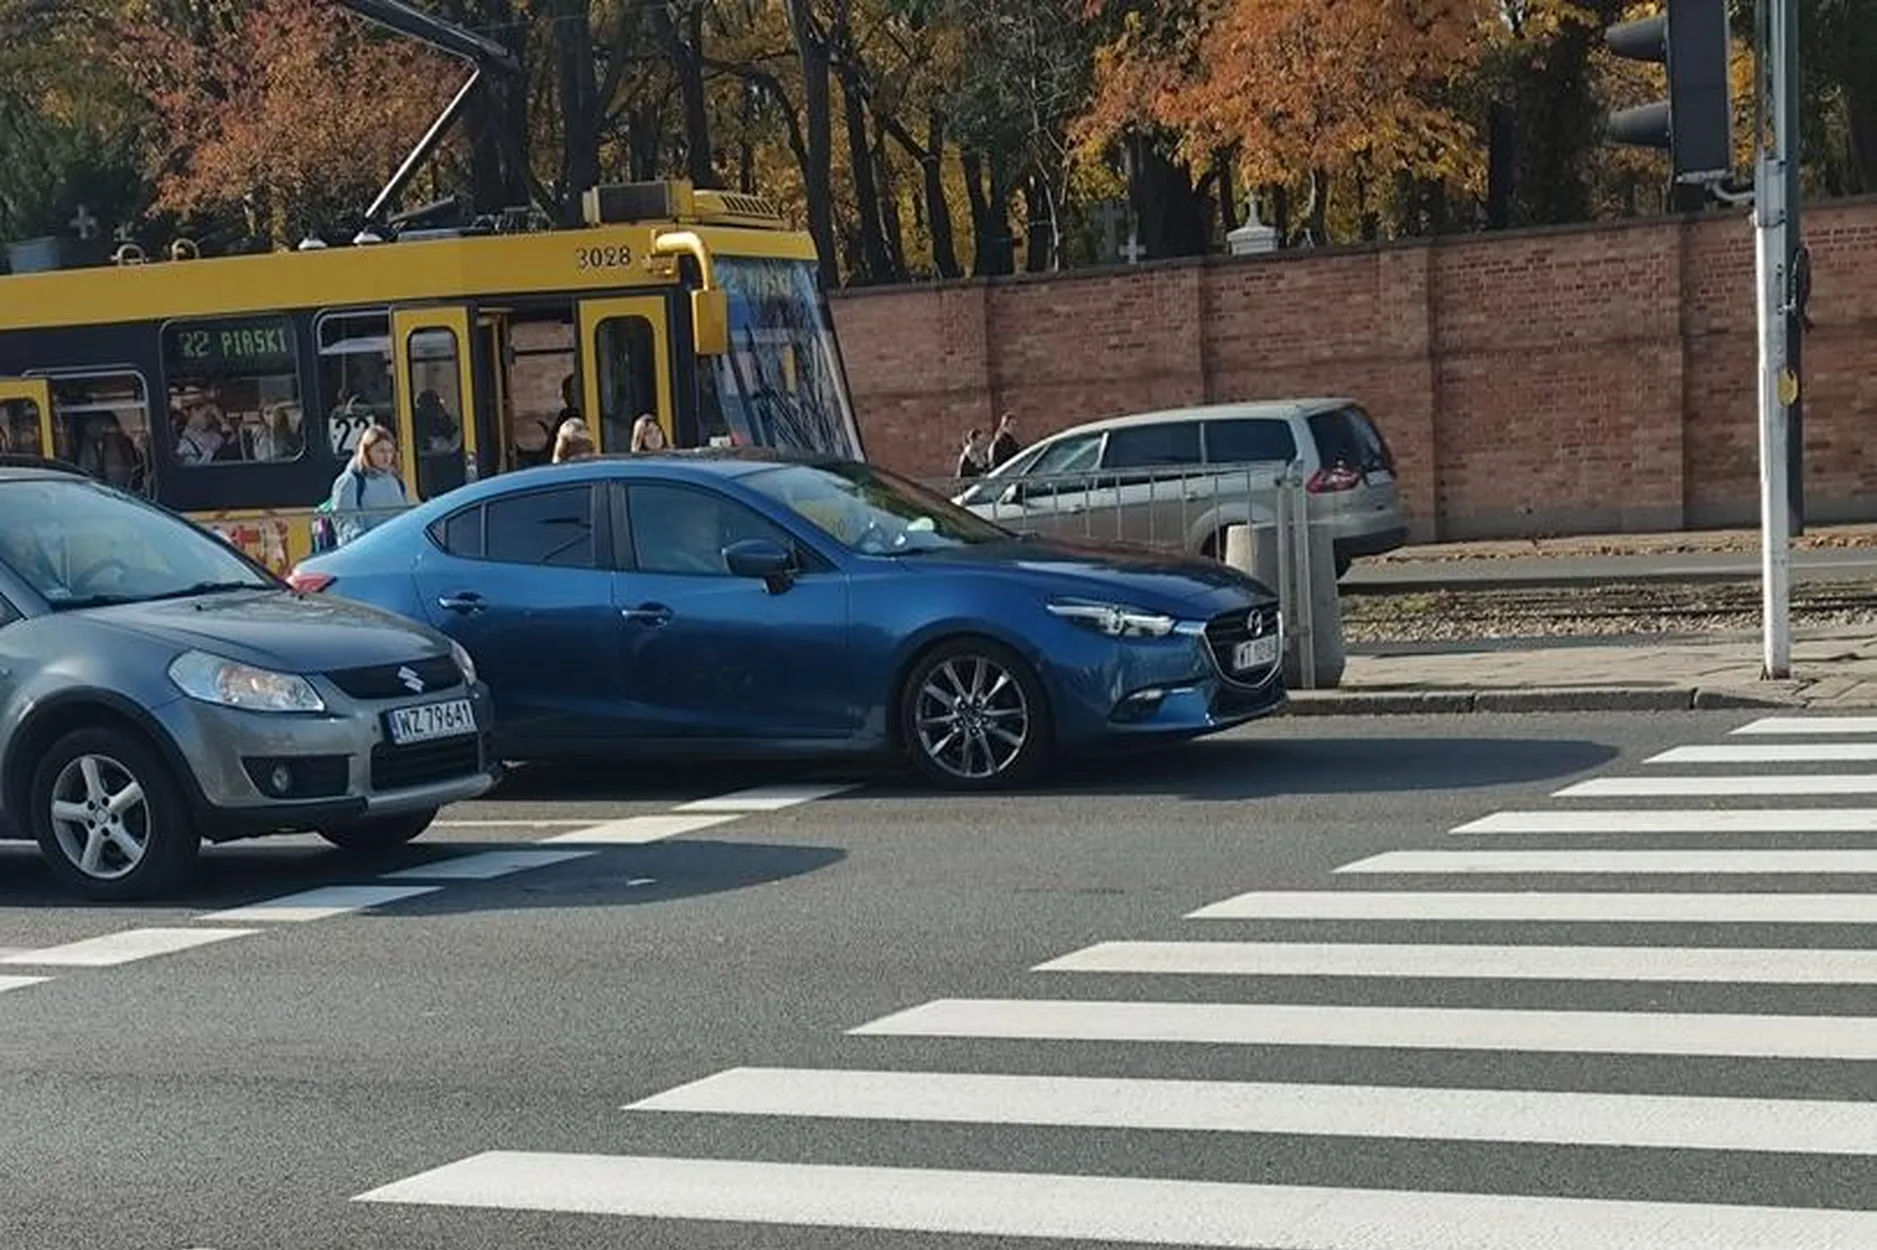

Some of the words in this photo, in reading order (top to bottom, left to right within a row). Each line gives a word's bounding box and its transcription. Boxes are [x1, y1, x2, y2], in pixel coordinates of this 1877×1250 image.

[575, 244, 631, 269] 3028
[179, 331, 210, 357] 22
[220, 327, 287, 357] PIASKI
[397, 709, 425, 736] WZ
